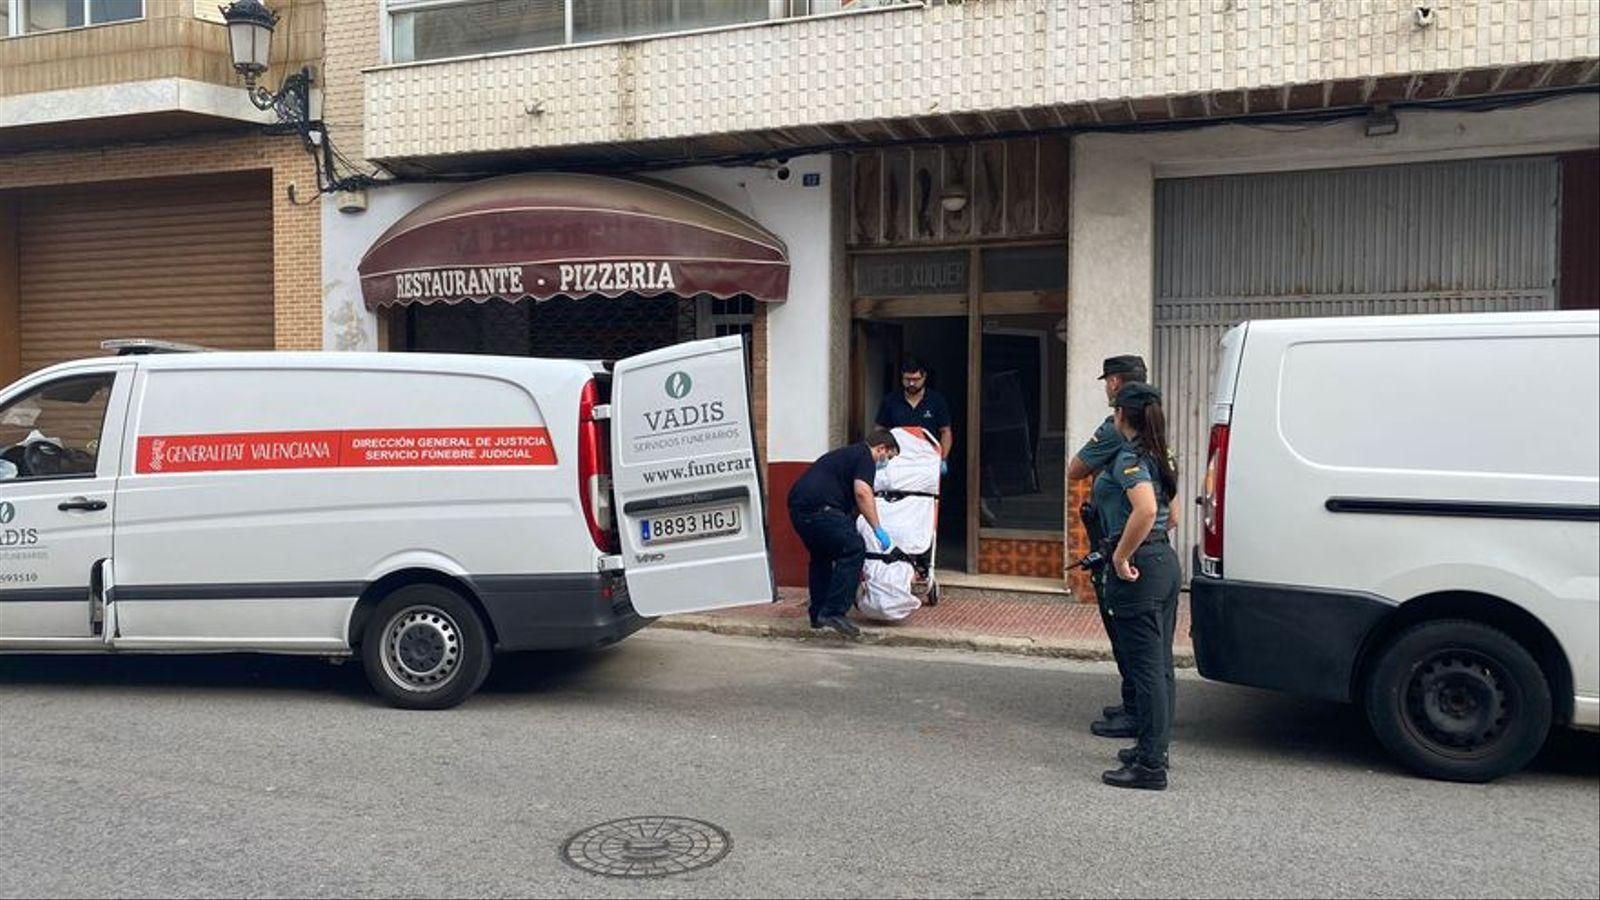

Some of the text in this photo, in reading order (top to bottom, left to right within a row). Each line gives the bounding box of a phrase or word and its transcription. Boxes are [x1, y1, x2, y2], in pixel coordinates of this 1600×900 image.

[396, 262, 676, 298] RESTAURANTE PIZZERIA
[643, 401, 725, 431] VADIS
[166, 441, 330, 463] GENERALITAT VALENCIANA
[352, 436, 546, 448] DIRECCIÓN GENERAL DE JUSTICIA
[634, 428, 740, 452] SERVICIOS FUNERARIOS
[365, 448, 532, 460] SERVICIO FÚNEBRE JUDICIAL
[653, 511, 737, 537] 8893 HGJ
